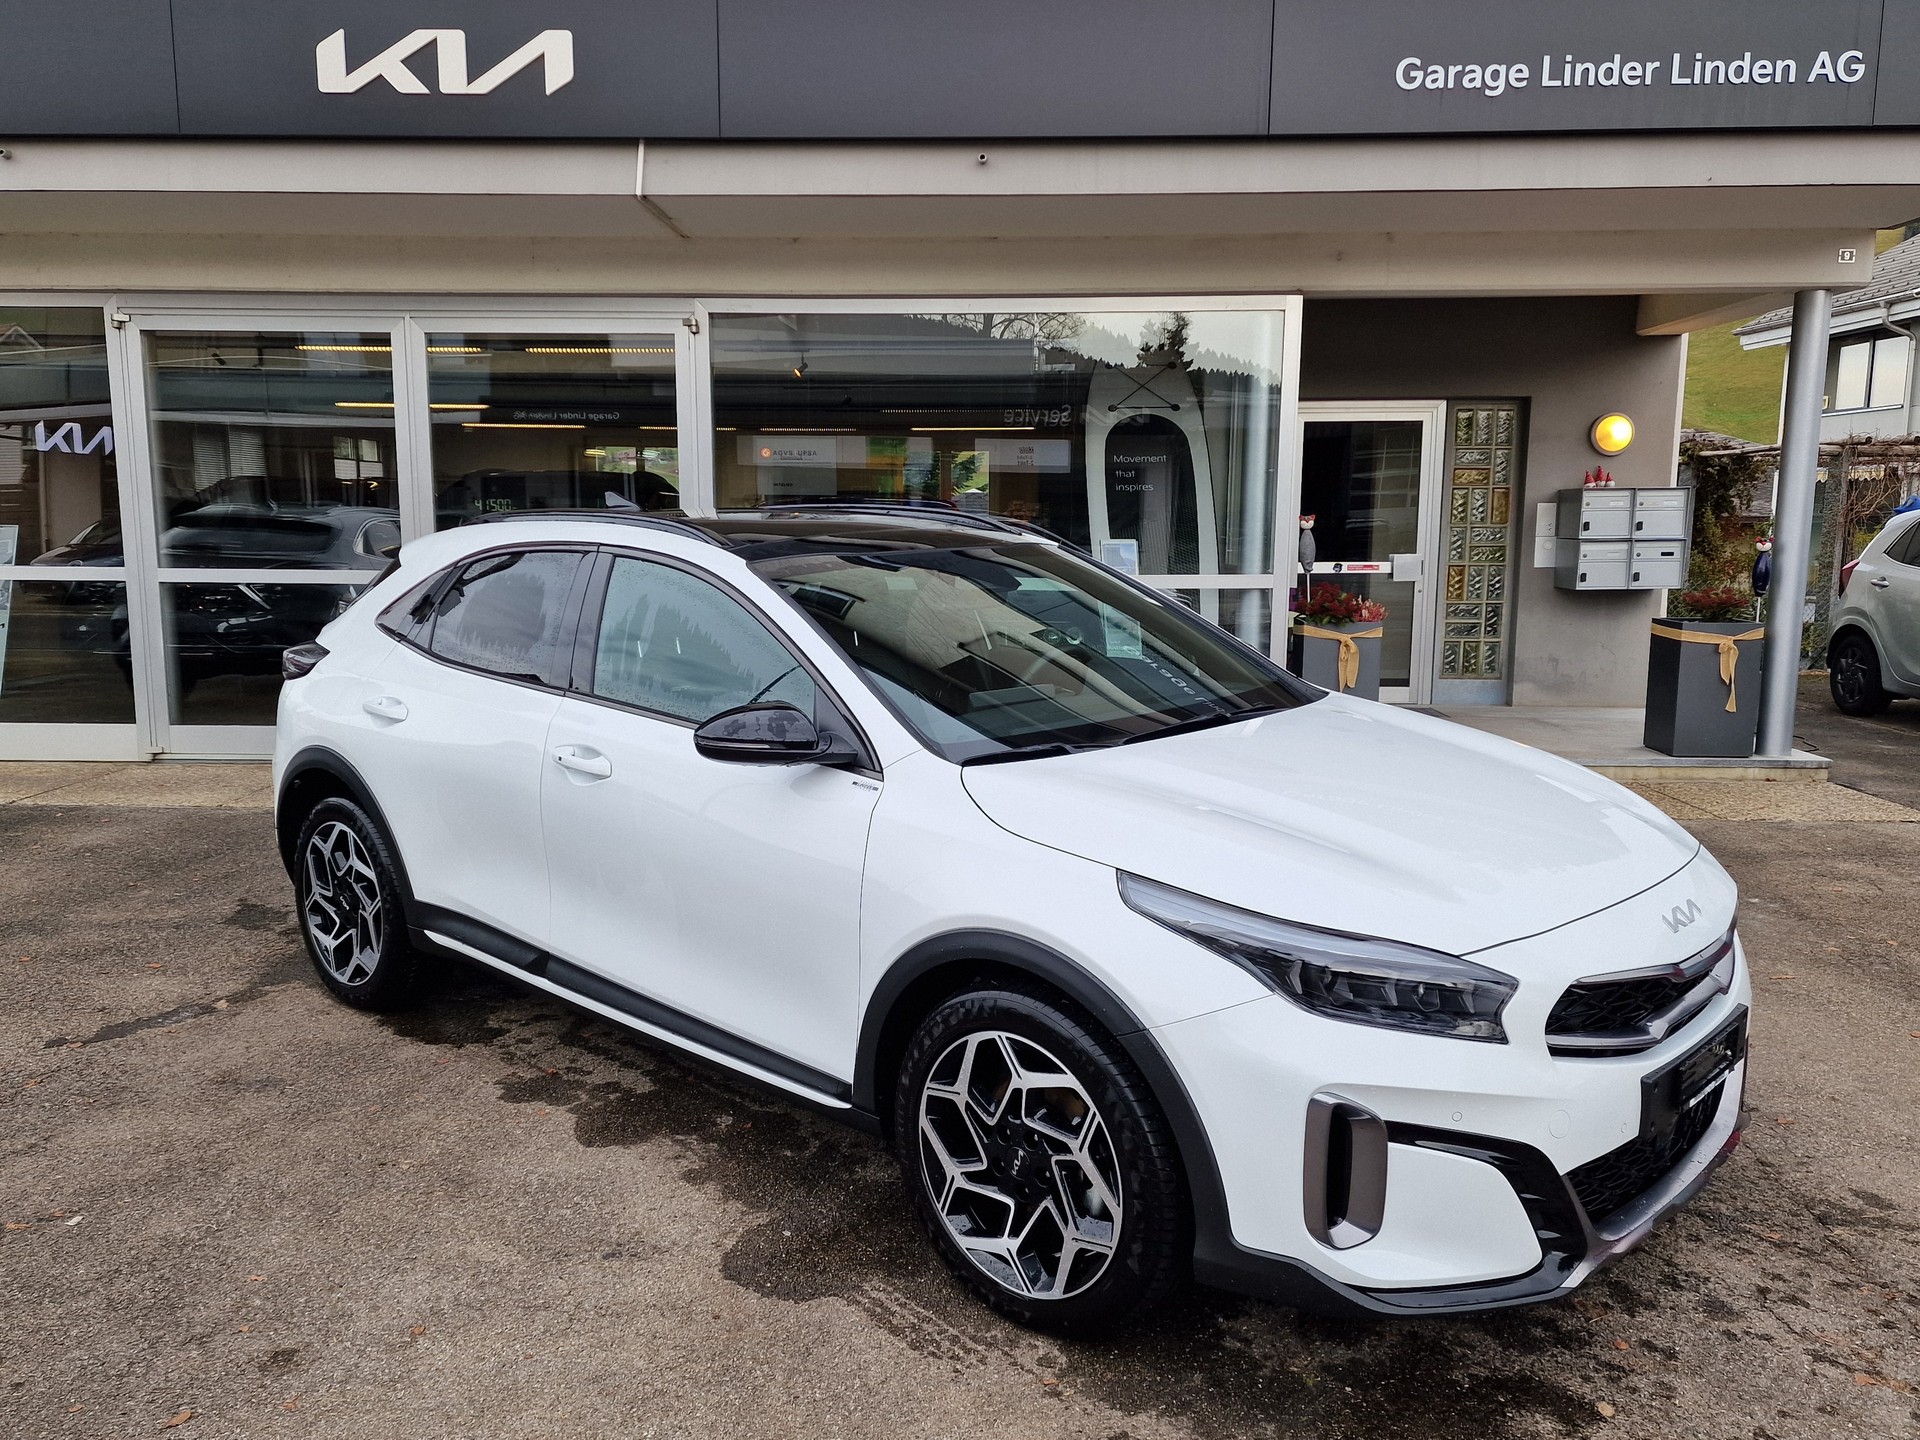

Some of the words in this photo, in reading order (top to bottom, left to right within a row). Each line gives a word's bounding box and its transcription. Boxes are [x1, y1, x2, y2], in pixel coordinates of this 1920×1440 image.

[315, 28, 575, 96] KIA
[1395, 56, 1530, 97] Garage
[1541, 53, 1661, 88] Linder
[1671, 51, 1797, 85] Linden
[1807, 49, 1866, 84] AG
[1843, 251, 1851, 260] 9
[1113, 454, 1167, 463] Movement
[1115, 469, 1135, 478] that
[1115, 483, 1154, 493] inspires
